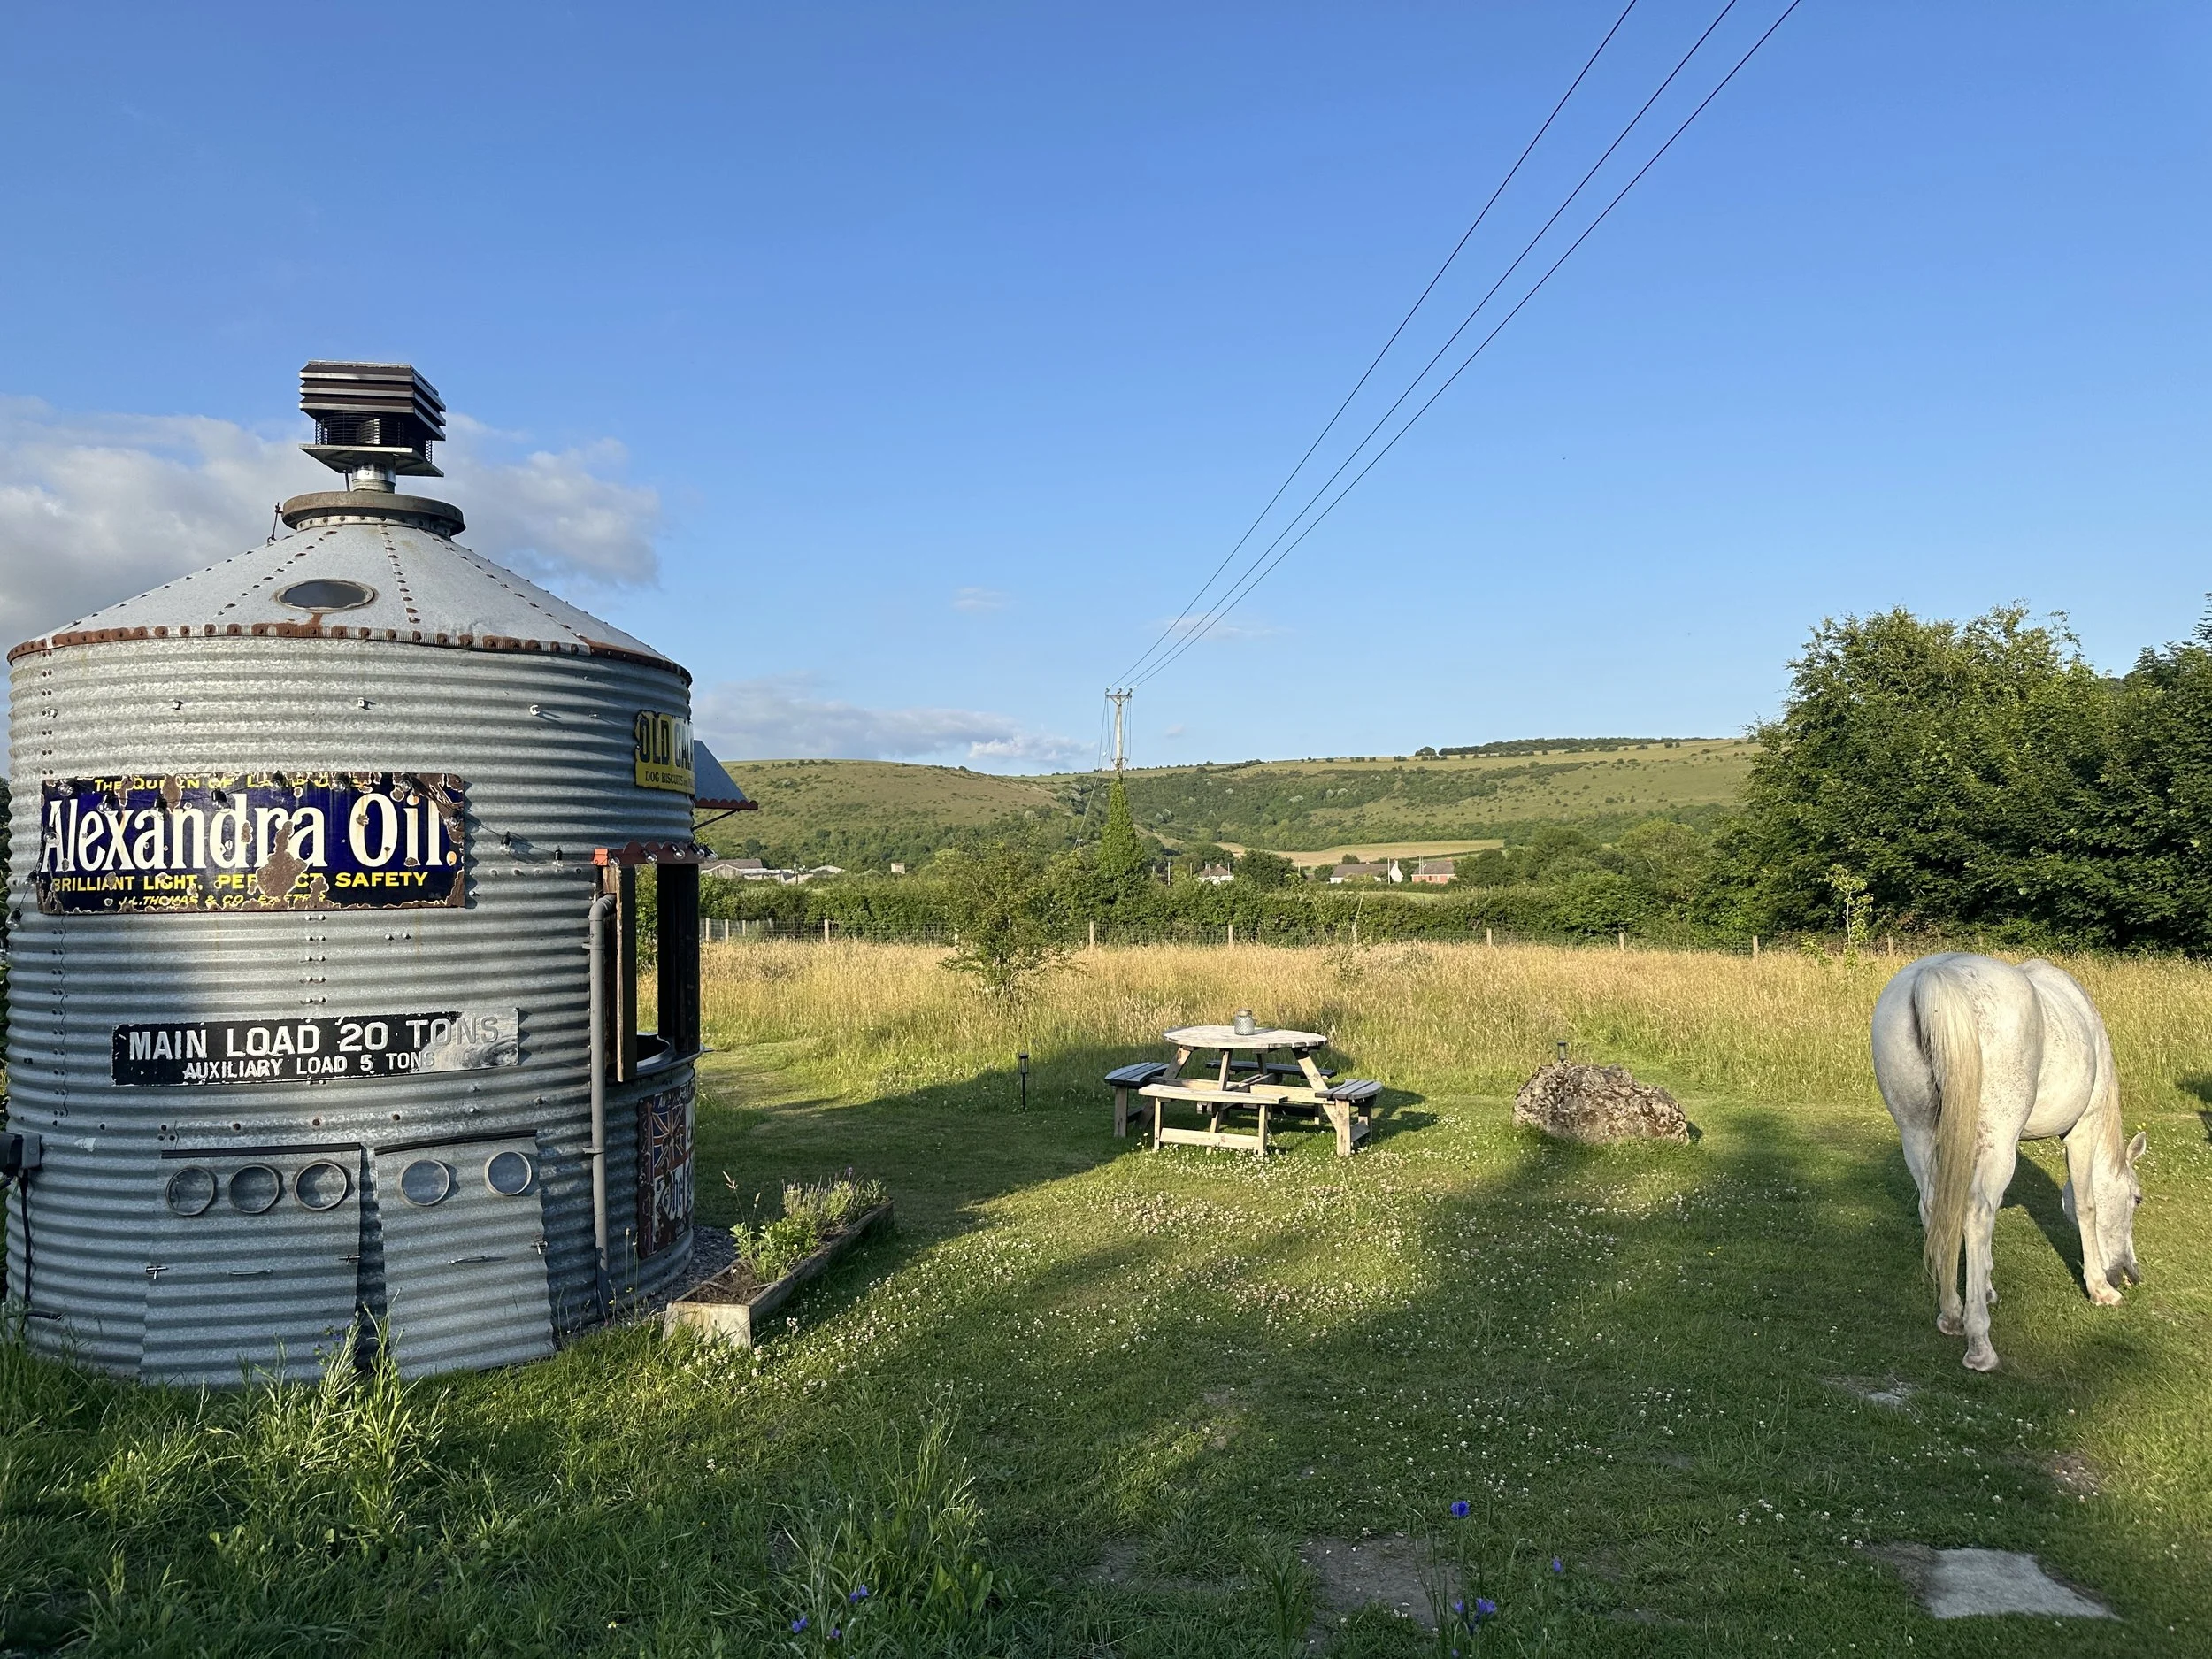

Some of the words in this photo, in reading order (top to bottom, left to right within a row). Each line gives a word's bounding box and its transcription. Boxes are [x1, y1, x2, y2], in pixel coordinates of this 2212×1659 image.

[639, 716, 670, 765] OLD
[645, 771, 659, 782] DOG
[661, 772, 683, 786] BISCUITS
[41, 794, 328, 872] Alexandra
[52, 876, 135, 892] BRILLIANT
[335, 872, 428, 887] SAFETY
[129, 1030, 207, 1060] MAIN
[227, 1025, 320, 1057] LOAD
[339, 1022, 389, 1052] 20
[405, 1017, 499, 1048] TONS
[182, 1058, 283, 1079] AUXILIARY
[296, 1056, 348, 1075] LOAD
[359, 1054, 373, 1071] 5
[385, 1050, 435, 1071] TONS
